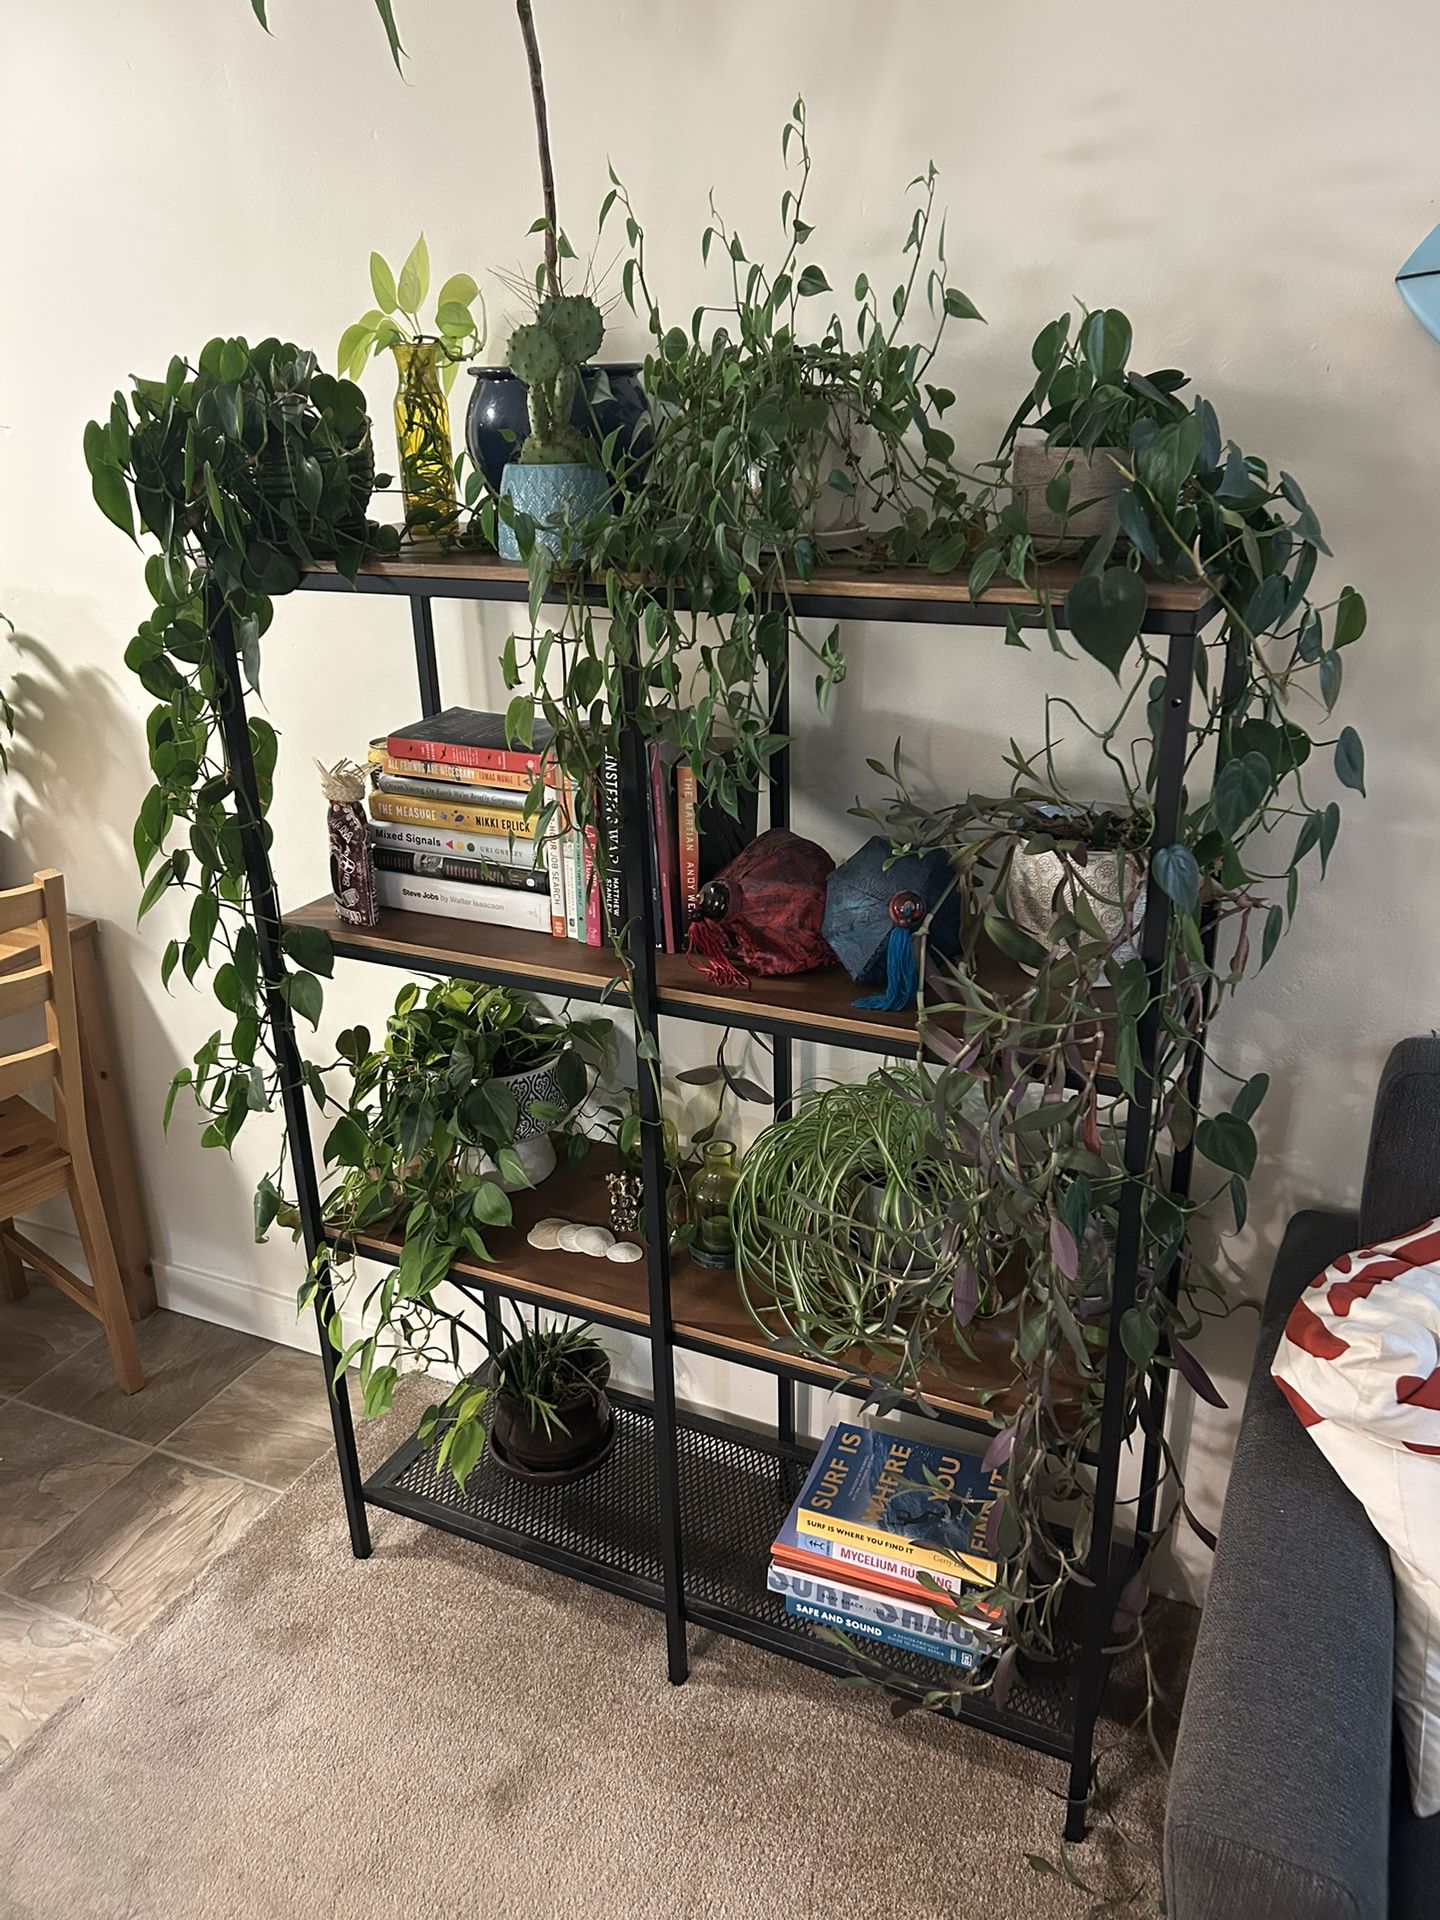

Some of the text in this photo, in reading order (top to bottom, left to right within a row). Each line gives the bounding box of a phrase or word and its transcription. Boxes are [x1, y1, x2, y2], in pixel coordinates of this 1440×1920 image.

[388, 759, 399, 770] ALL
[440, 764, 475, 779] NECESSARY
[377, 803, 437, 821] THE MEASURE
[475, 815, 531, 833] NIKKI ERLICK
[684, 777, 695, 851] THE MARTIAN
[375, 829, 442, 847] Mixed Signals
[494, 847, 524, 858] GNEZY
[550, 851, 560, 869] JOB
[401, 888, 505, 911] Steve Jobs by Walter Isaacson
[551, 871, 561, 905] SEARCH
[612, 877, 620, 917] MATTHEW
[686, 861, 697, 919] ANDY WE
[810, 1456, 850, 1510] SURF
[837, 1432, 862, 1455] IS
[860, 1443, 912, 1521] WHERE
[927, 1455, 961, 1501] YOU
[806, 1519, 915, 1555] SURF IS WHERE YOU FIND IT
[840, 1547, 898, 1574] MYCELIUM
[840, 1597, 865, 1609] SHACK
[795, 1603, 820, 1618] SAFE
[820, 1610, 844, 1625] AND
[845, 1619, 883, 1637] SOUND
